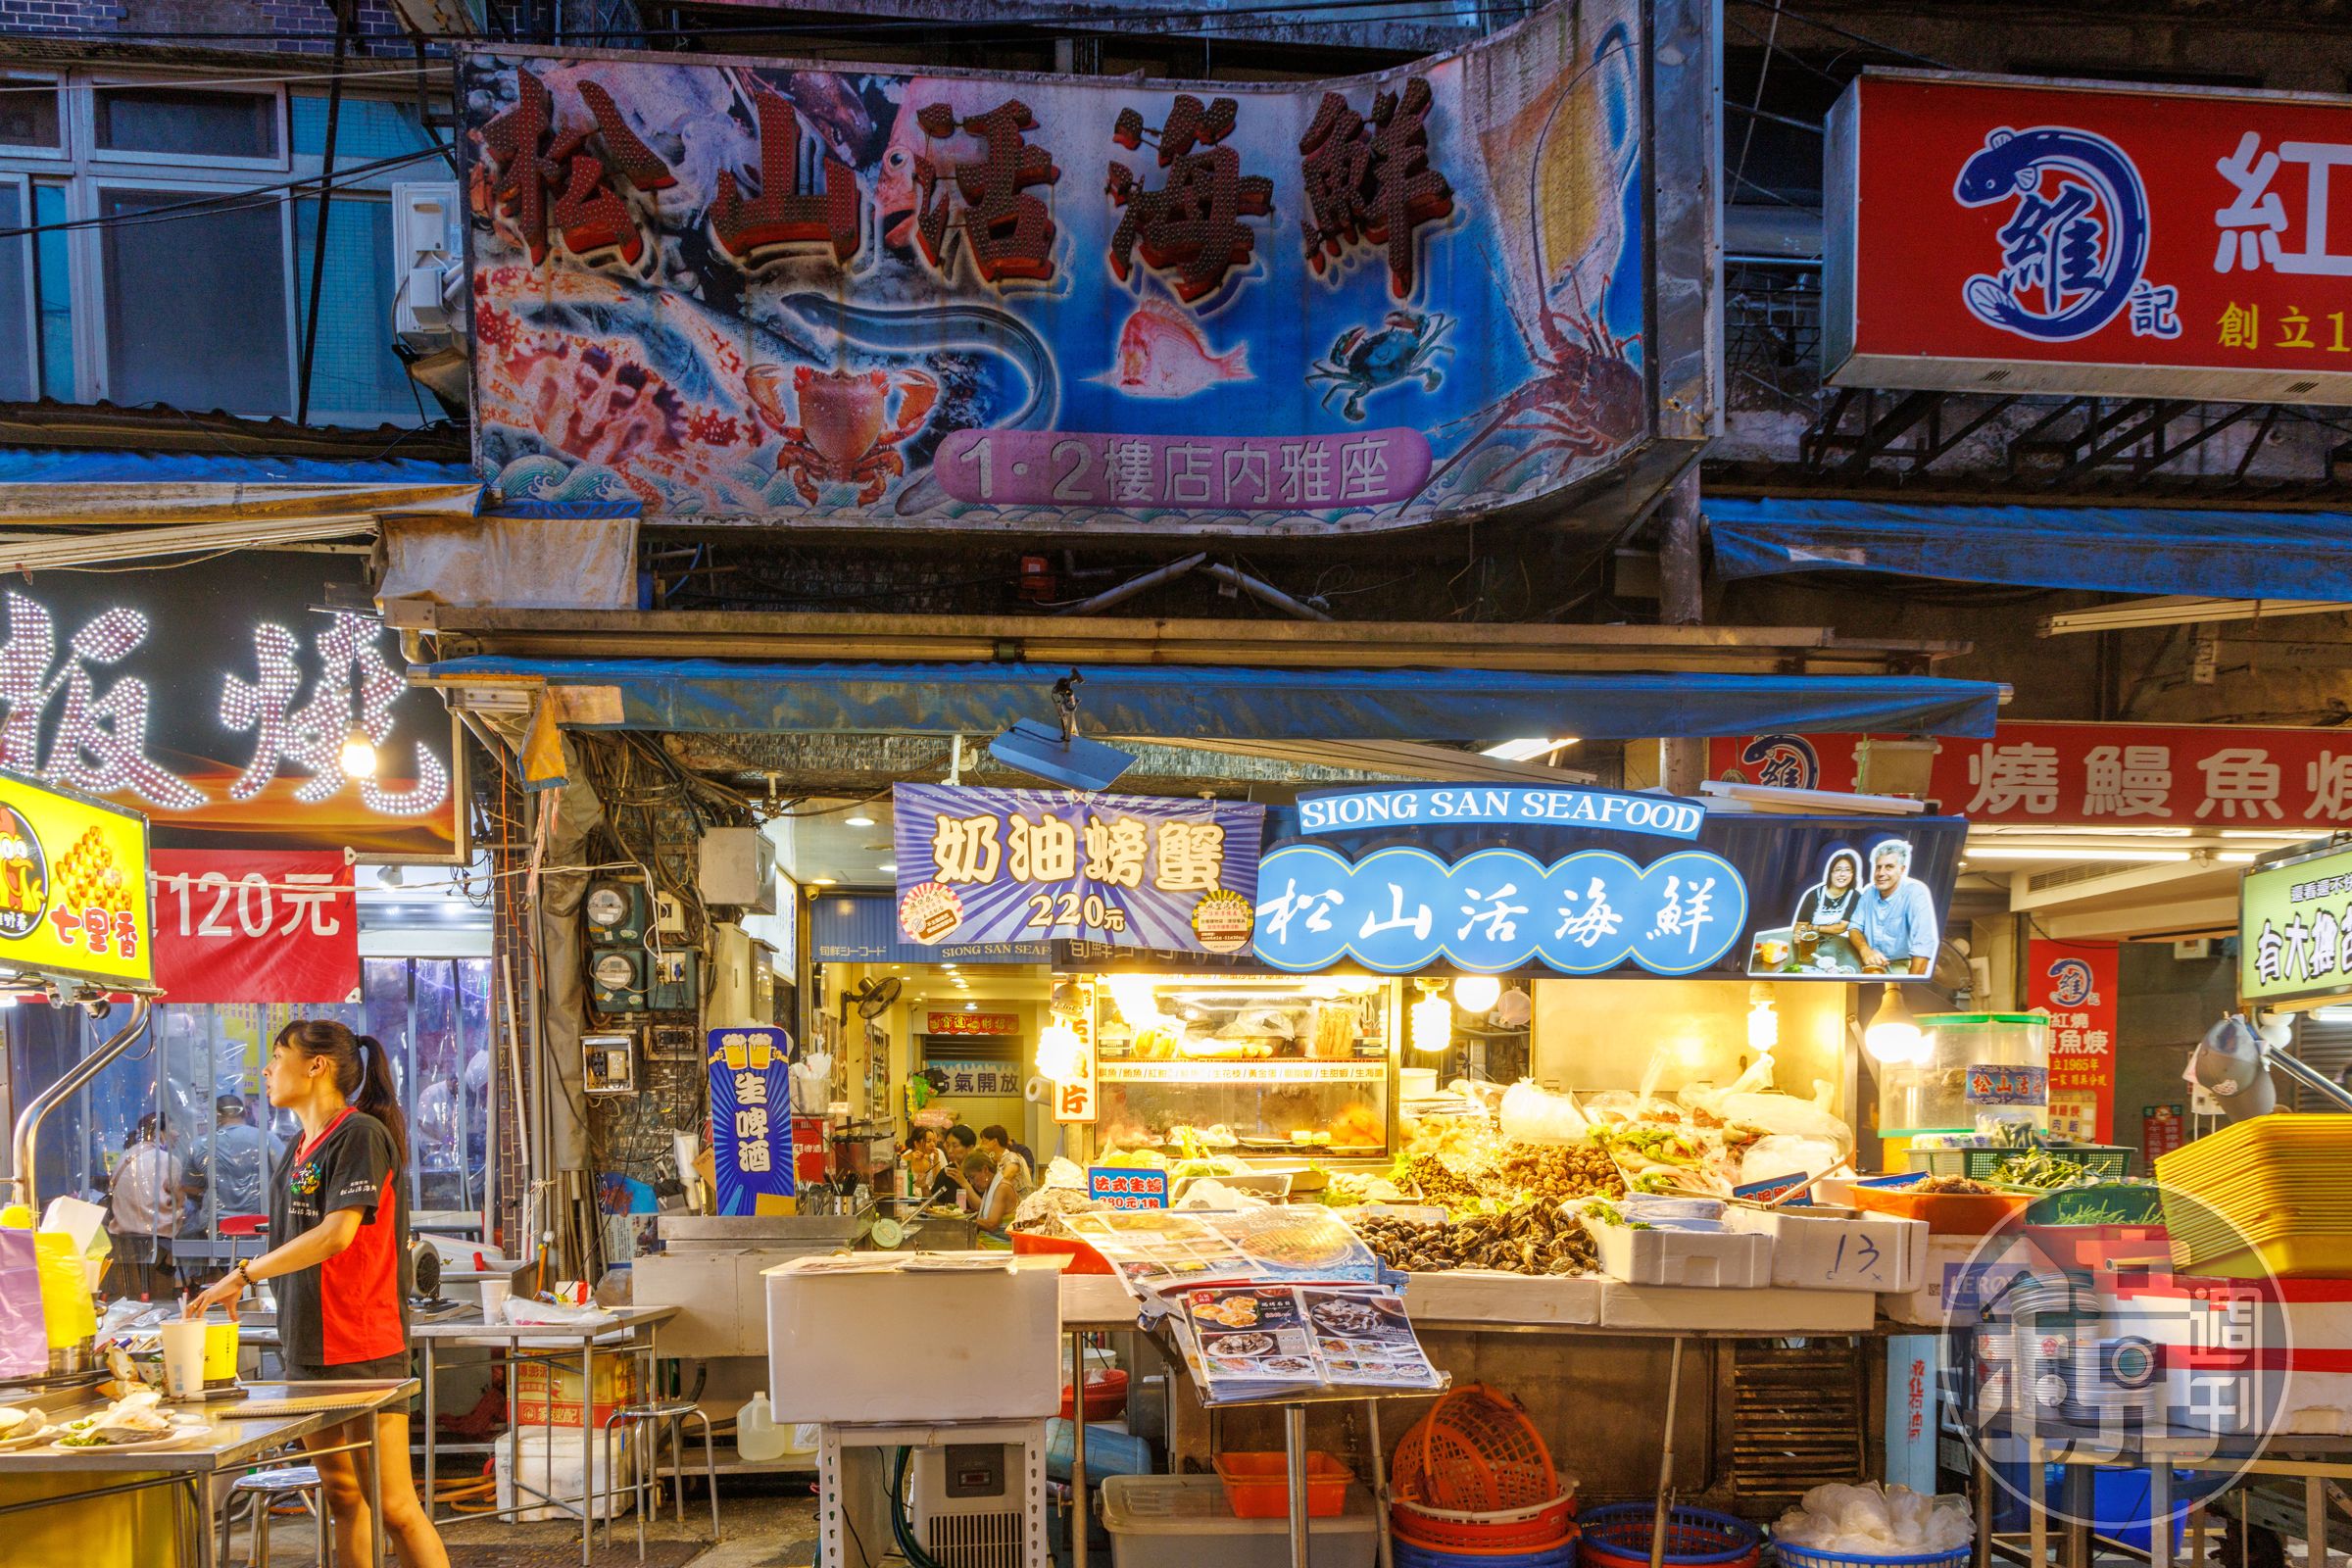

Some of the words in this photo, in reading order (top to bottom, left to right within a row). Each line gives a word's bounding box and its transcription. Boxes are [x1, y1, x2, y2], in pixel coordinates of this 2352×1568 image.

[486, 70, 1454, 297] 松山活海鮮
[1300, 795, 1417, 827] SIONG
[1428, 791, 1510, 818] SAN
[1521, 790, 1700, 833] SEAFOOD
[933, 814, 1226, 891] 奶油螃蟹
[49, 904, 139, 959] 七里香
[150, 870, 339, 938] 120元
[1026, 892, 1126, 932] 220元
[1255, 876, 1716, 955] 松山活海鮮
[941, 946, 981, 957] SIONG
[985, 944, 1011, 955] SAN
[1014, 943, 1052, 955] SEAF
[734, 1072, 772, 1173] 生啤酒
[1095, 1176, 1163, 1194] 法式生蠔
[1834, 1234, 1880, 1273] 13
